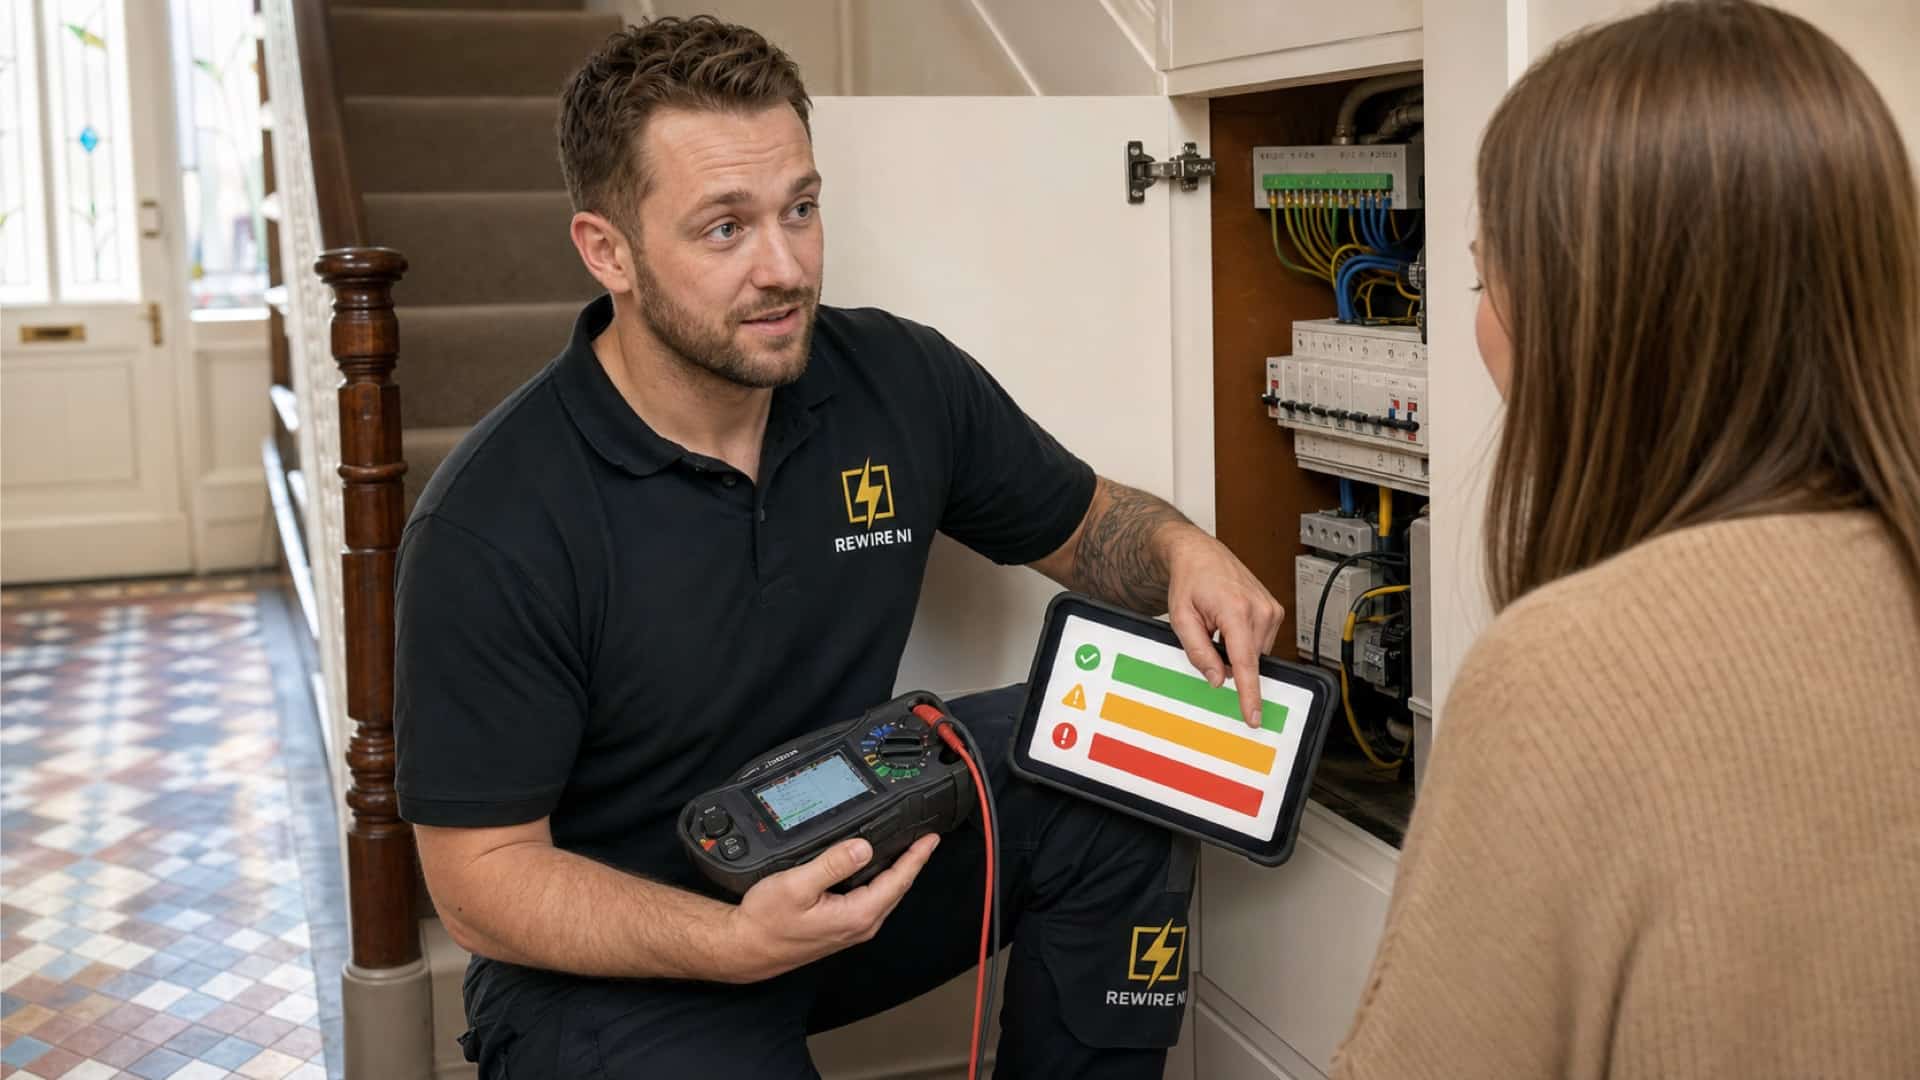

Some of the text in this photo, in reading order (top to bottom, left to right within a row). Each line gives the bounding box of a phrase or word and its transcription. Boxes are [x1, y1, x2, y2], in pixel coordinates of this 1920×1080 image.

[834, 528, 912, 553] REWIRE NI
[1106, 991, 1175, 1006] REWIRE
